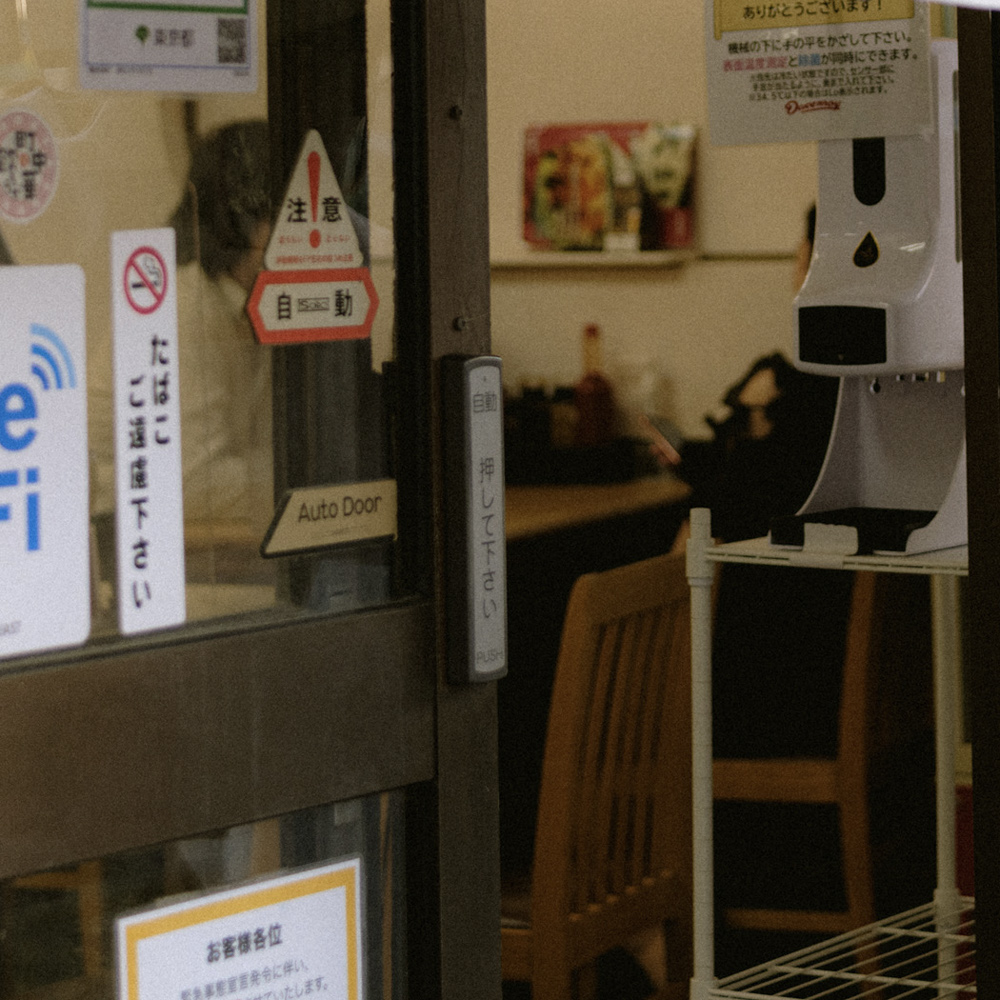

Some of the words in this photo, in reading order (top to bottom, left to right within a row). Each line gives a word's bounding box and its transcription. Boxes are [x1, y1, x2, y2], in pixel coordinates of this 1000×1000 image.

[287, 197, 342, 223] 注意
[151, 335, 171, 445] たばこ
[473, 390, 498, 414] 自動
[298, 500, 338, 524] Auto
[342, 493, 383, 516] Door
[479, 457, 498, 619] 押して下さい
[206, 923, 283, 964] お客様各位
